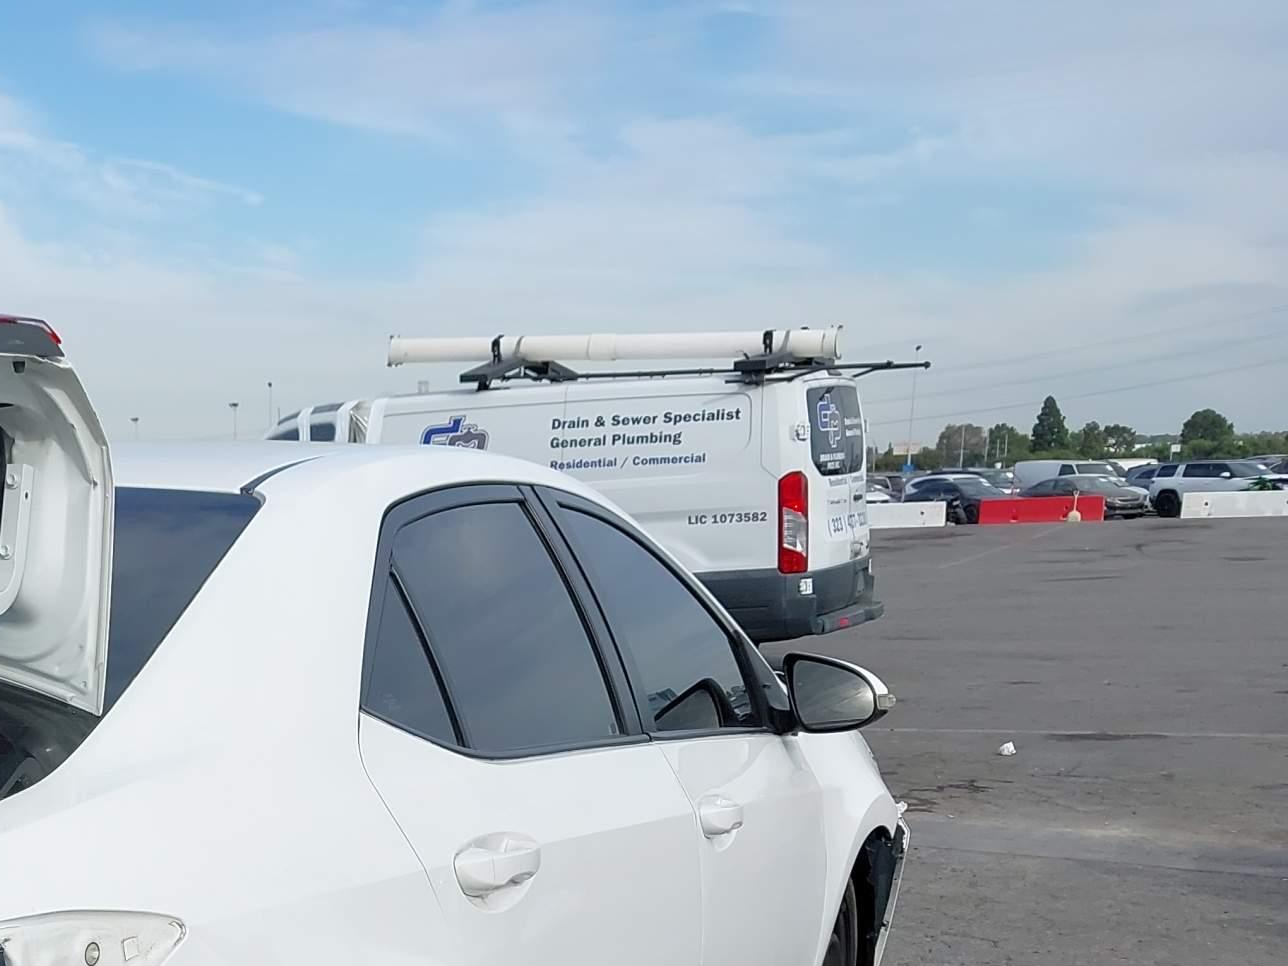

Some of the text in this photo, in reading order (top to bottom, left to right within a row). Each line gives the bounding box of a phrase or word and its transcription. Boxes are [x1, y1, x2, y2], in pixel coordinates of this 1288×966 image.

[551, 407, 742, 431] Drain & Sewer Specialist
[550, 431, 682, 449] General Plumbing
[550, 453, 706, 471] Residential / Commercial
[688, 511, 768, 525] LIC 1073582
